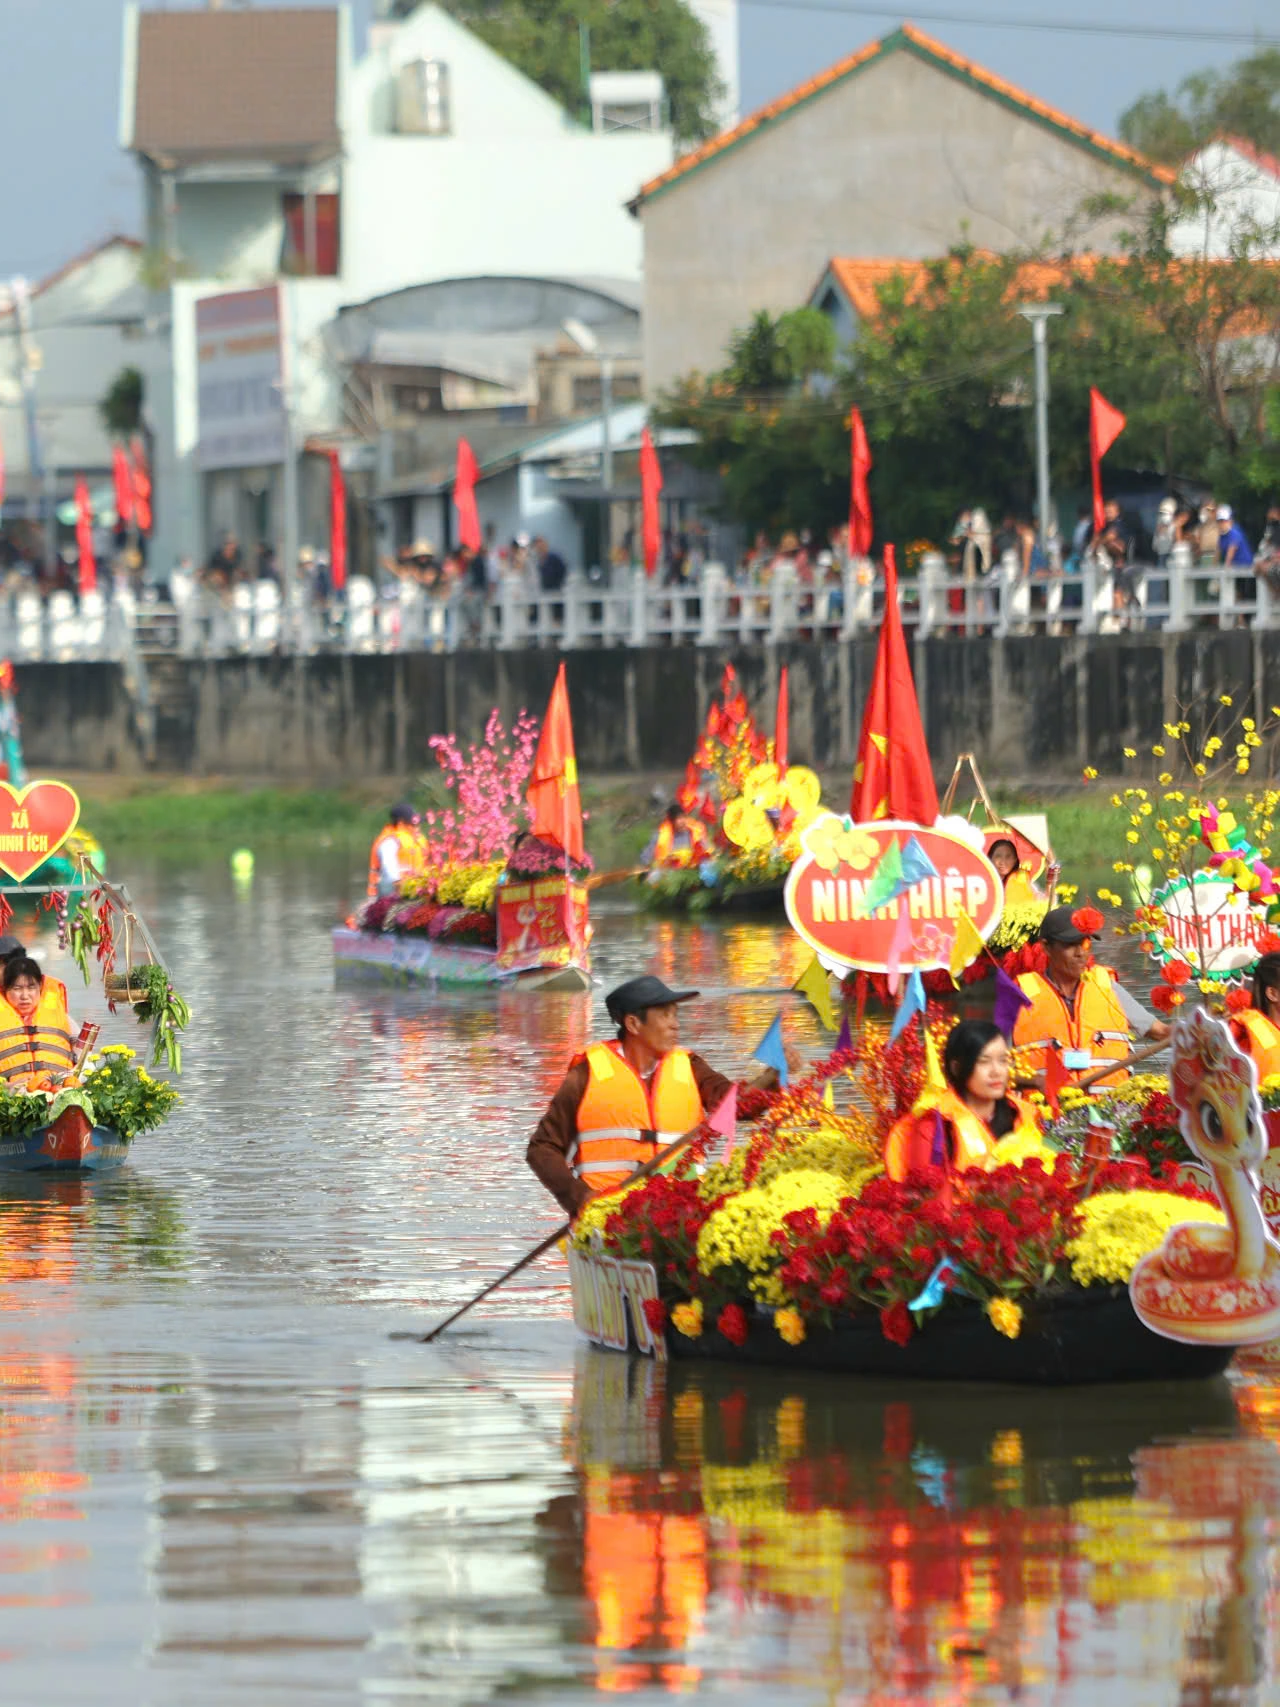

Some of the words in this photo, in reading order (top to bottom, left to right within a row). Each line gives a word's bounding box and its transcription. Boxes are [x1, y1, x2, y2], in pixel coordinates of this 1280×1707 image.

[11, 808, 29, 829] XÃ
[26, 831, 48, 853] ÍCH
[909, 867, 988, 927] HIỆP
